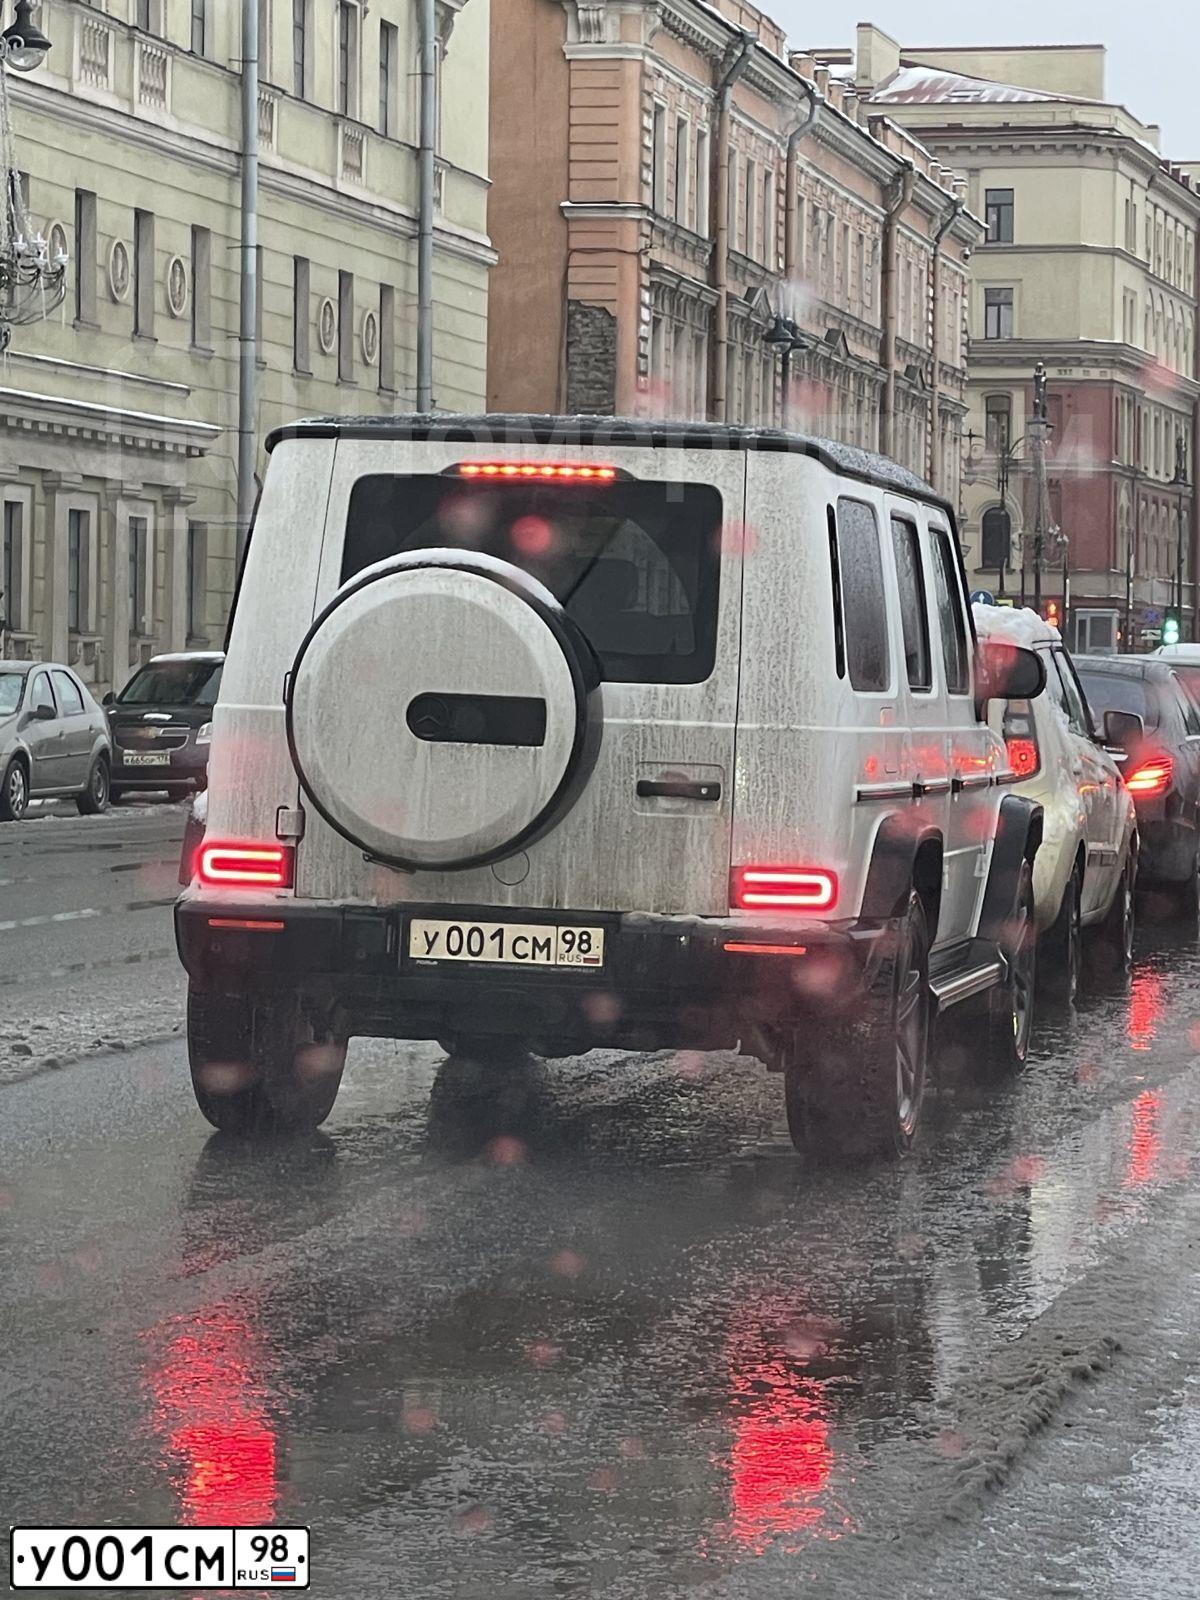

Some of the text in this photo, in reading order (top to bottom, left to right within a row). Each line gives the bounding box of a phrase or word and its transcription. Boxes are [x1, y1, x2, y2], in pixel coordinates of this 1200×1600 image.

[423, 925, 592, 961] У001СМ 98
[559, 953, 582, 963] RUS
